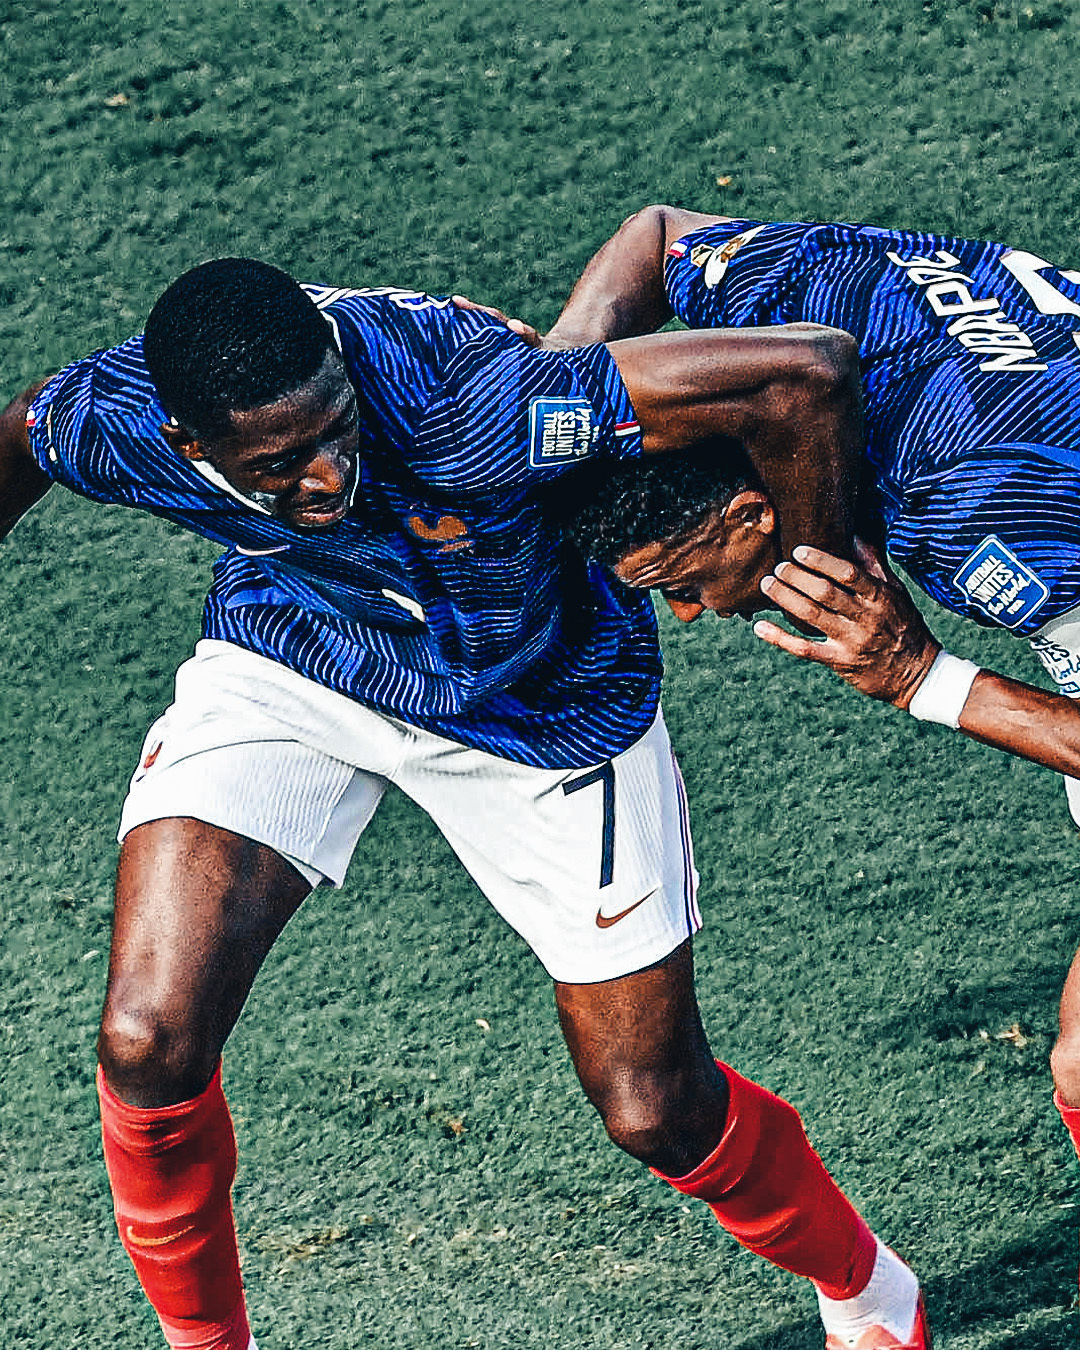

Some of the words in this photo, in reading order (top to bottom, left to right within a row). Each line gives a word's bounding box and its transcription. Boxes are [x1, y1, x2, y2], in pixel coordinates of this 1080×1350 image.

[542, 411, 558, 457] FOOTBALL
[555, 410, 576, 457] UNITES
[562, 759, 616, 889] 7
